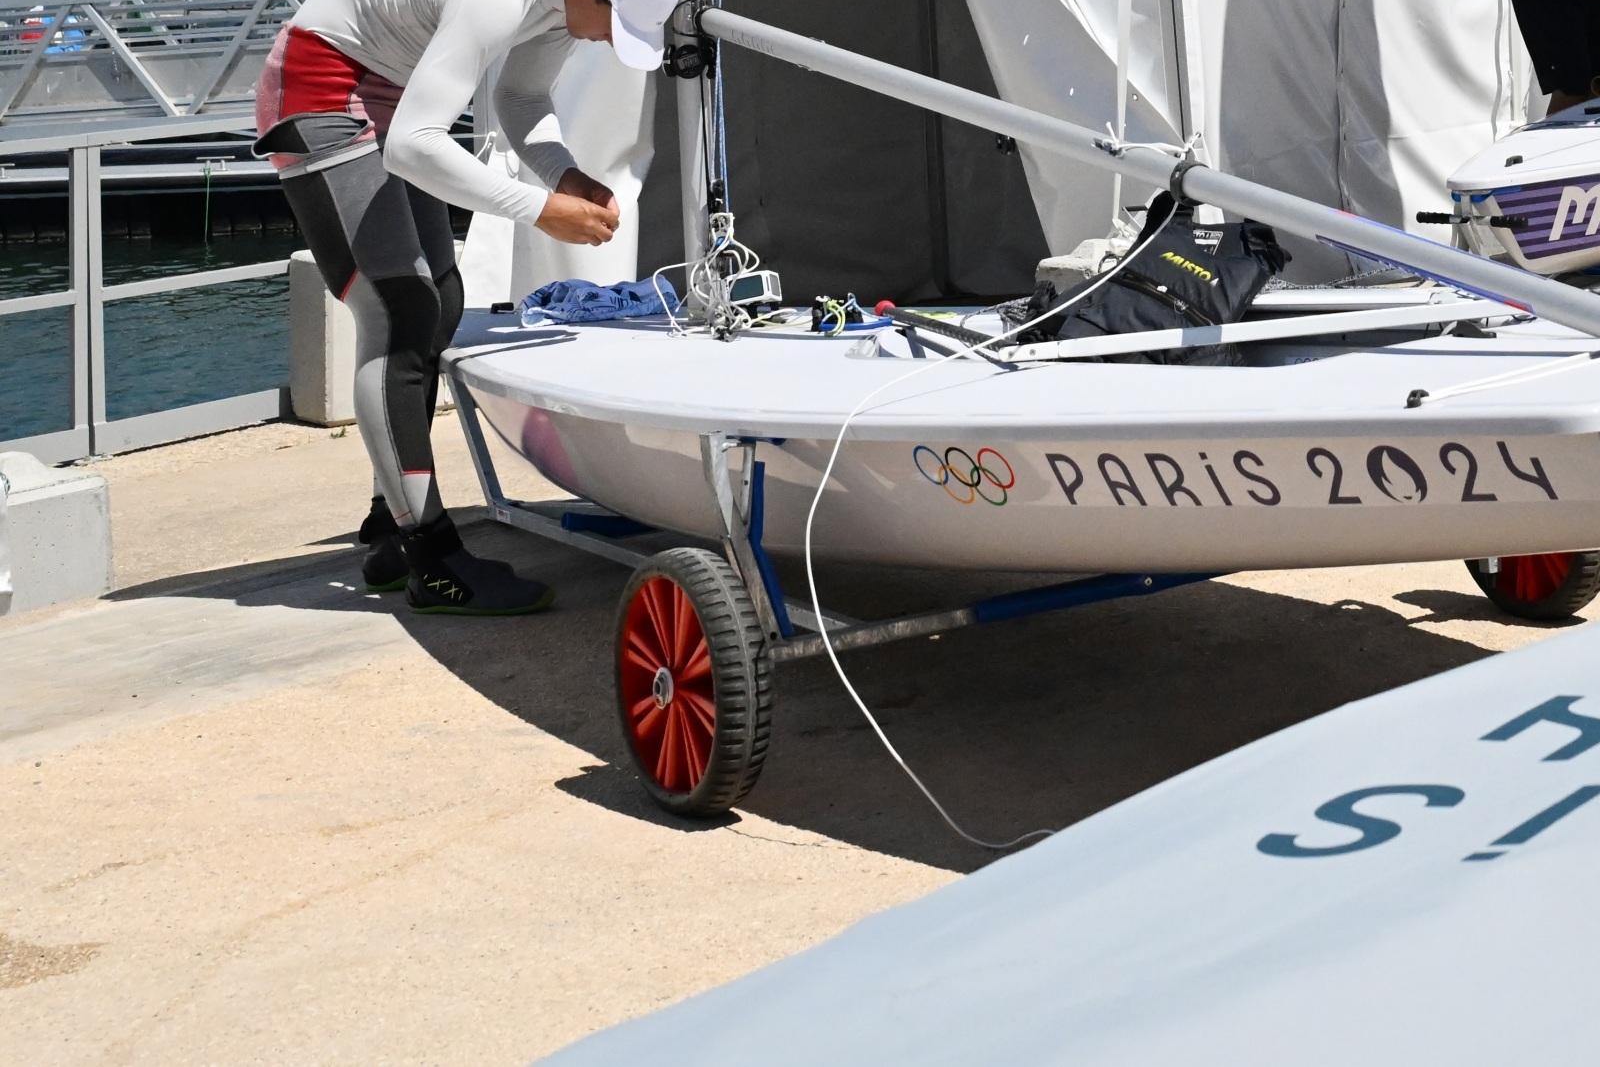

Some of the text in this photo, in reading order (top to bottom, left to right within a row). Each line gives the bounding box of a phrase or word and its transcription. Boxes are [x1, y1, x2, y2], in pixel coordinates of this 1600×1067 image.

[1161, 251, 1212, 282] MUSTO
[1045, 441, 1560, 506] PARIS 2024
